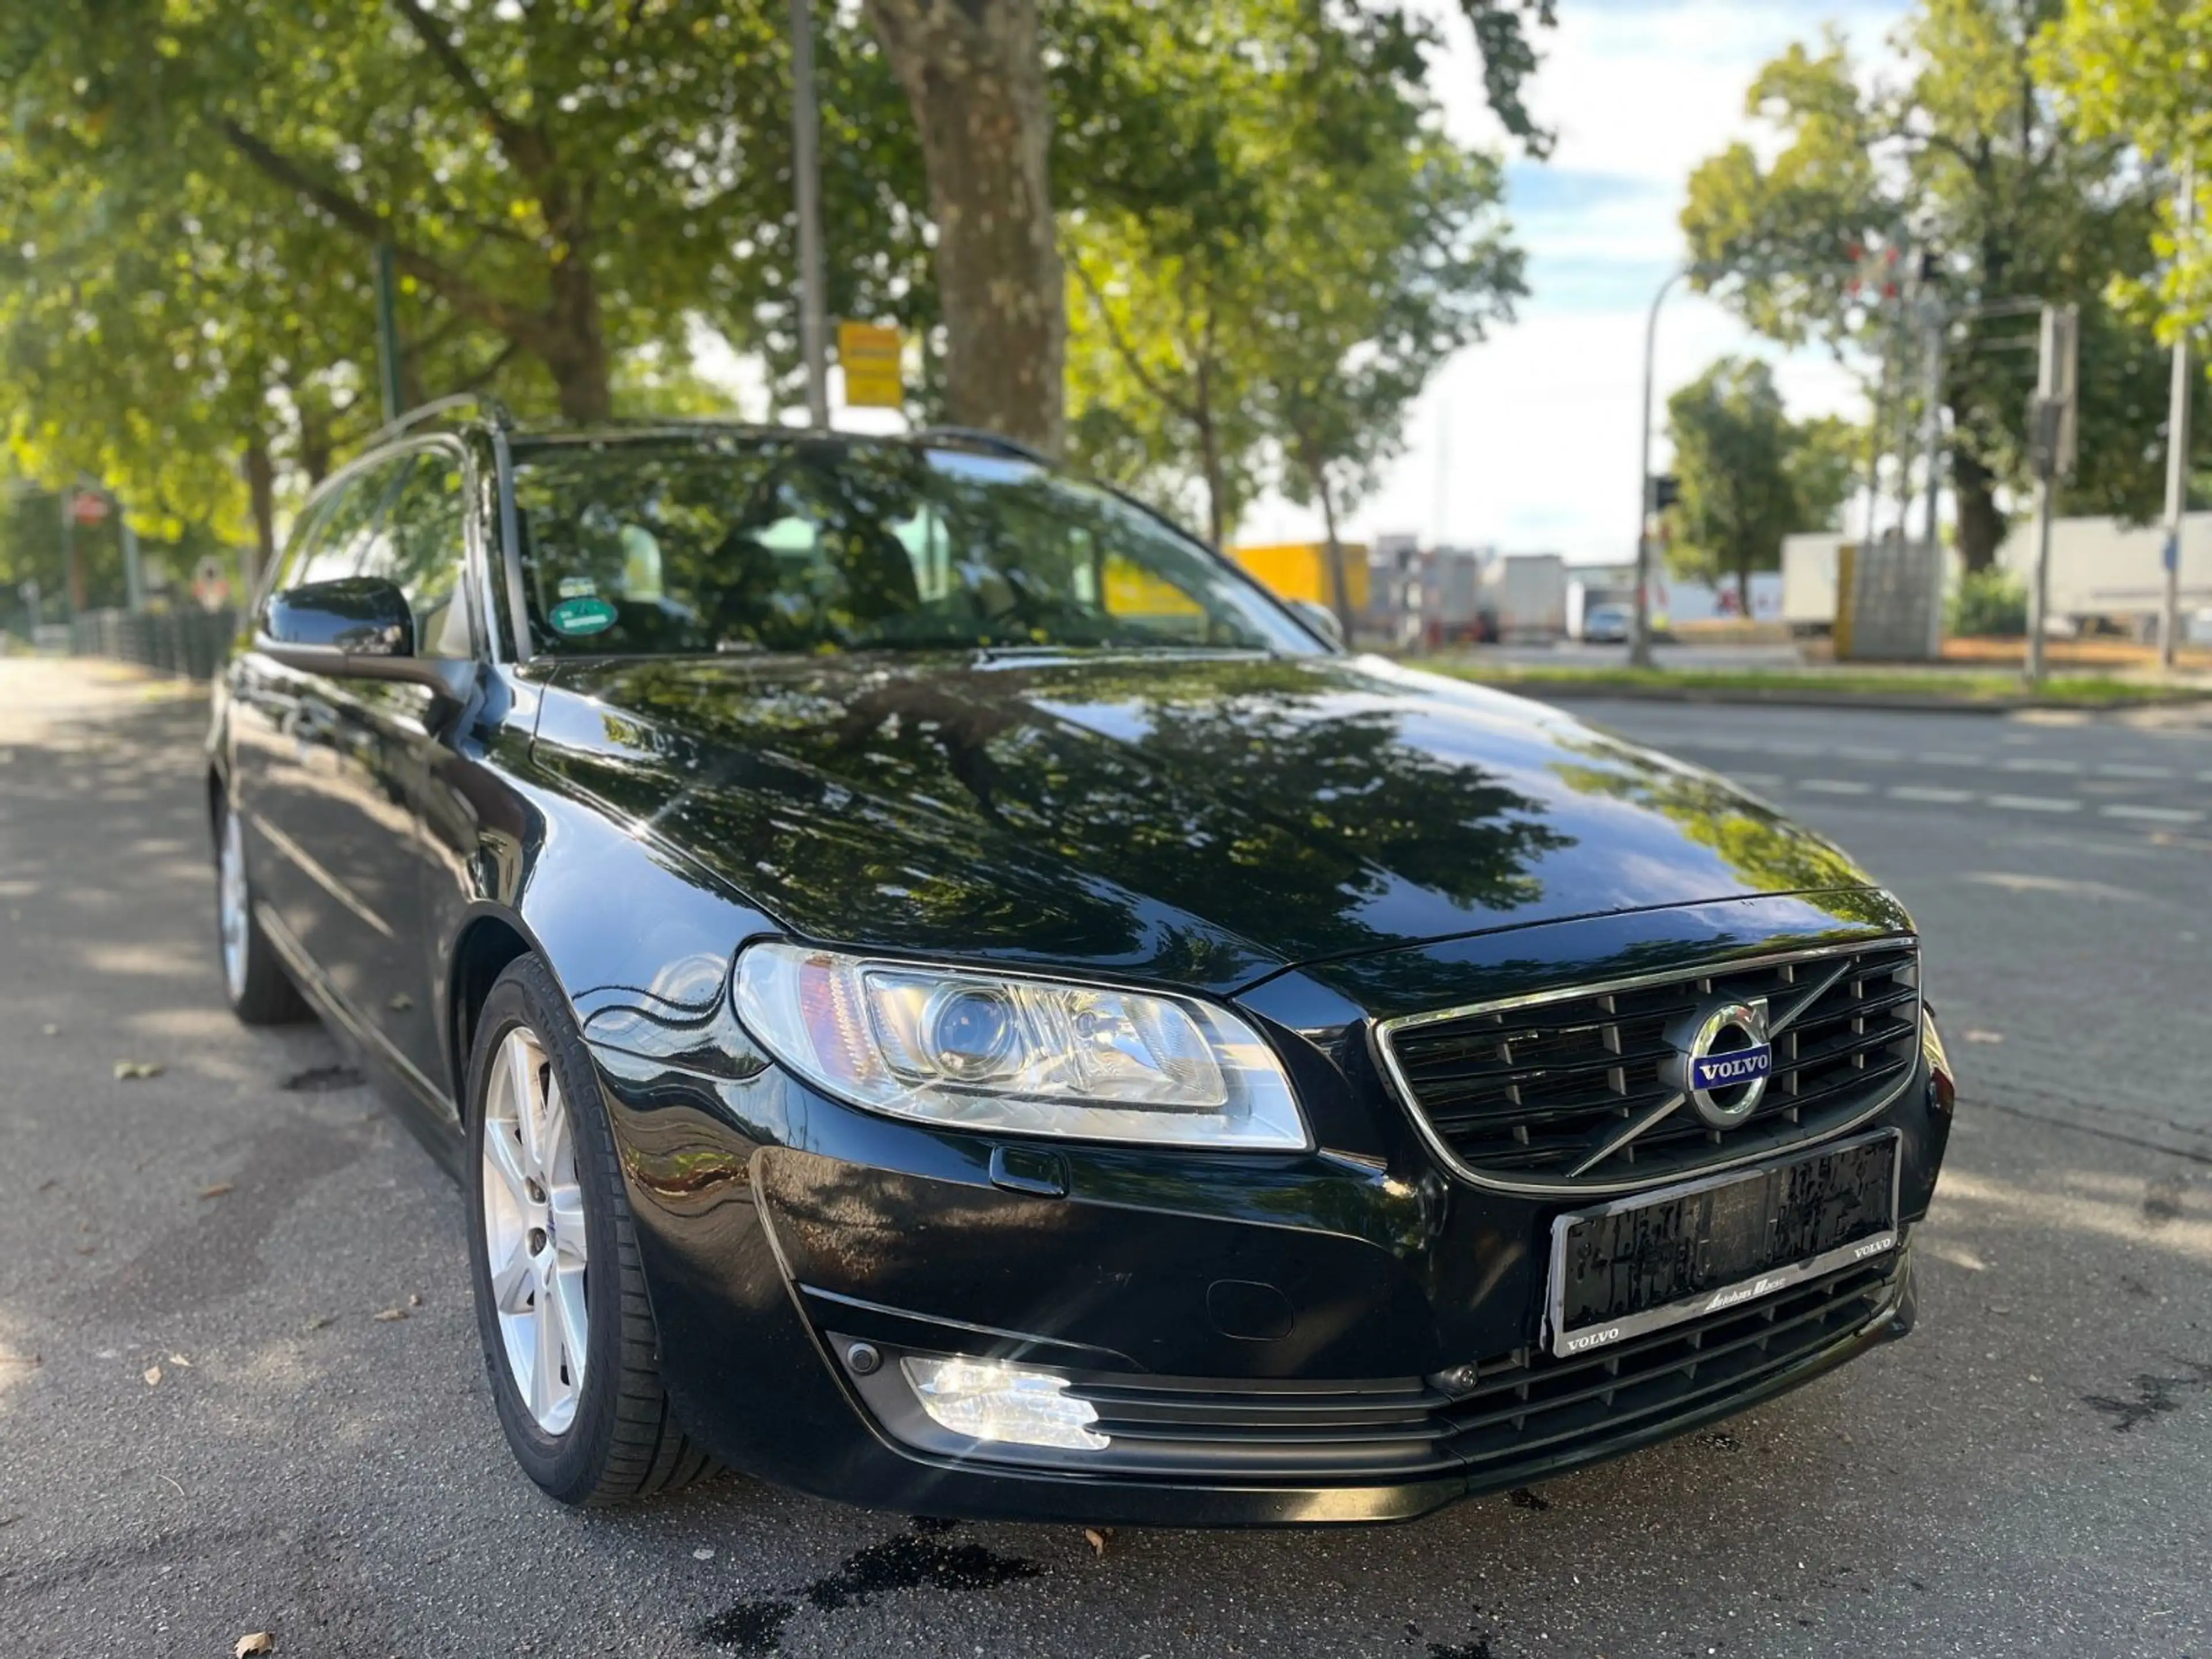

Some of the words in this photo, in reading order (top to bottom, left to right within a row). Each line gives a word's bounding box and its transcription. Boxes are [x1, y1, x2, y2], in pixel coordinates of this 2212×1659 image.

[1699, 1054, 1768, 1081] VOLVO
[1854, 1238, 1891, 1258] VOLVO
[1567, 1328, 1619, 1351] VOLVO
